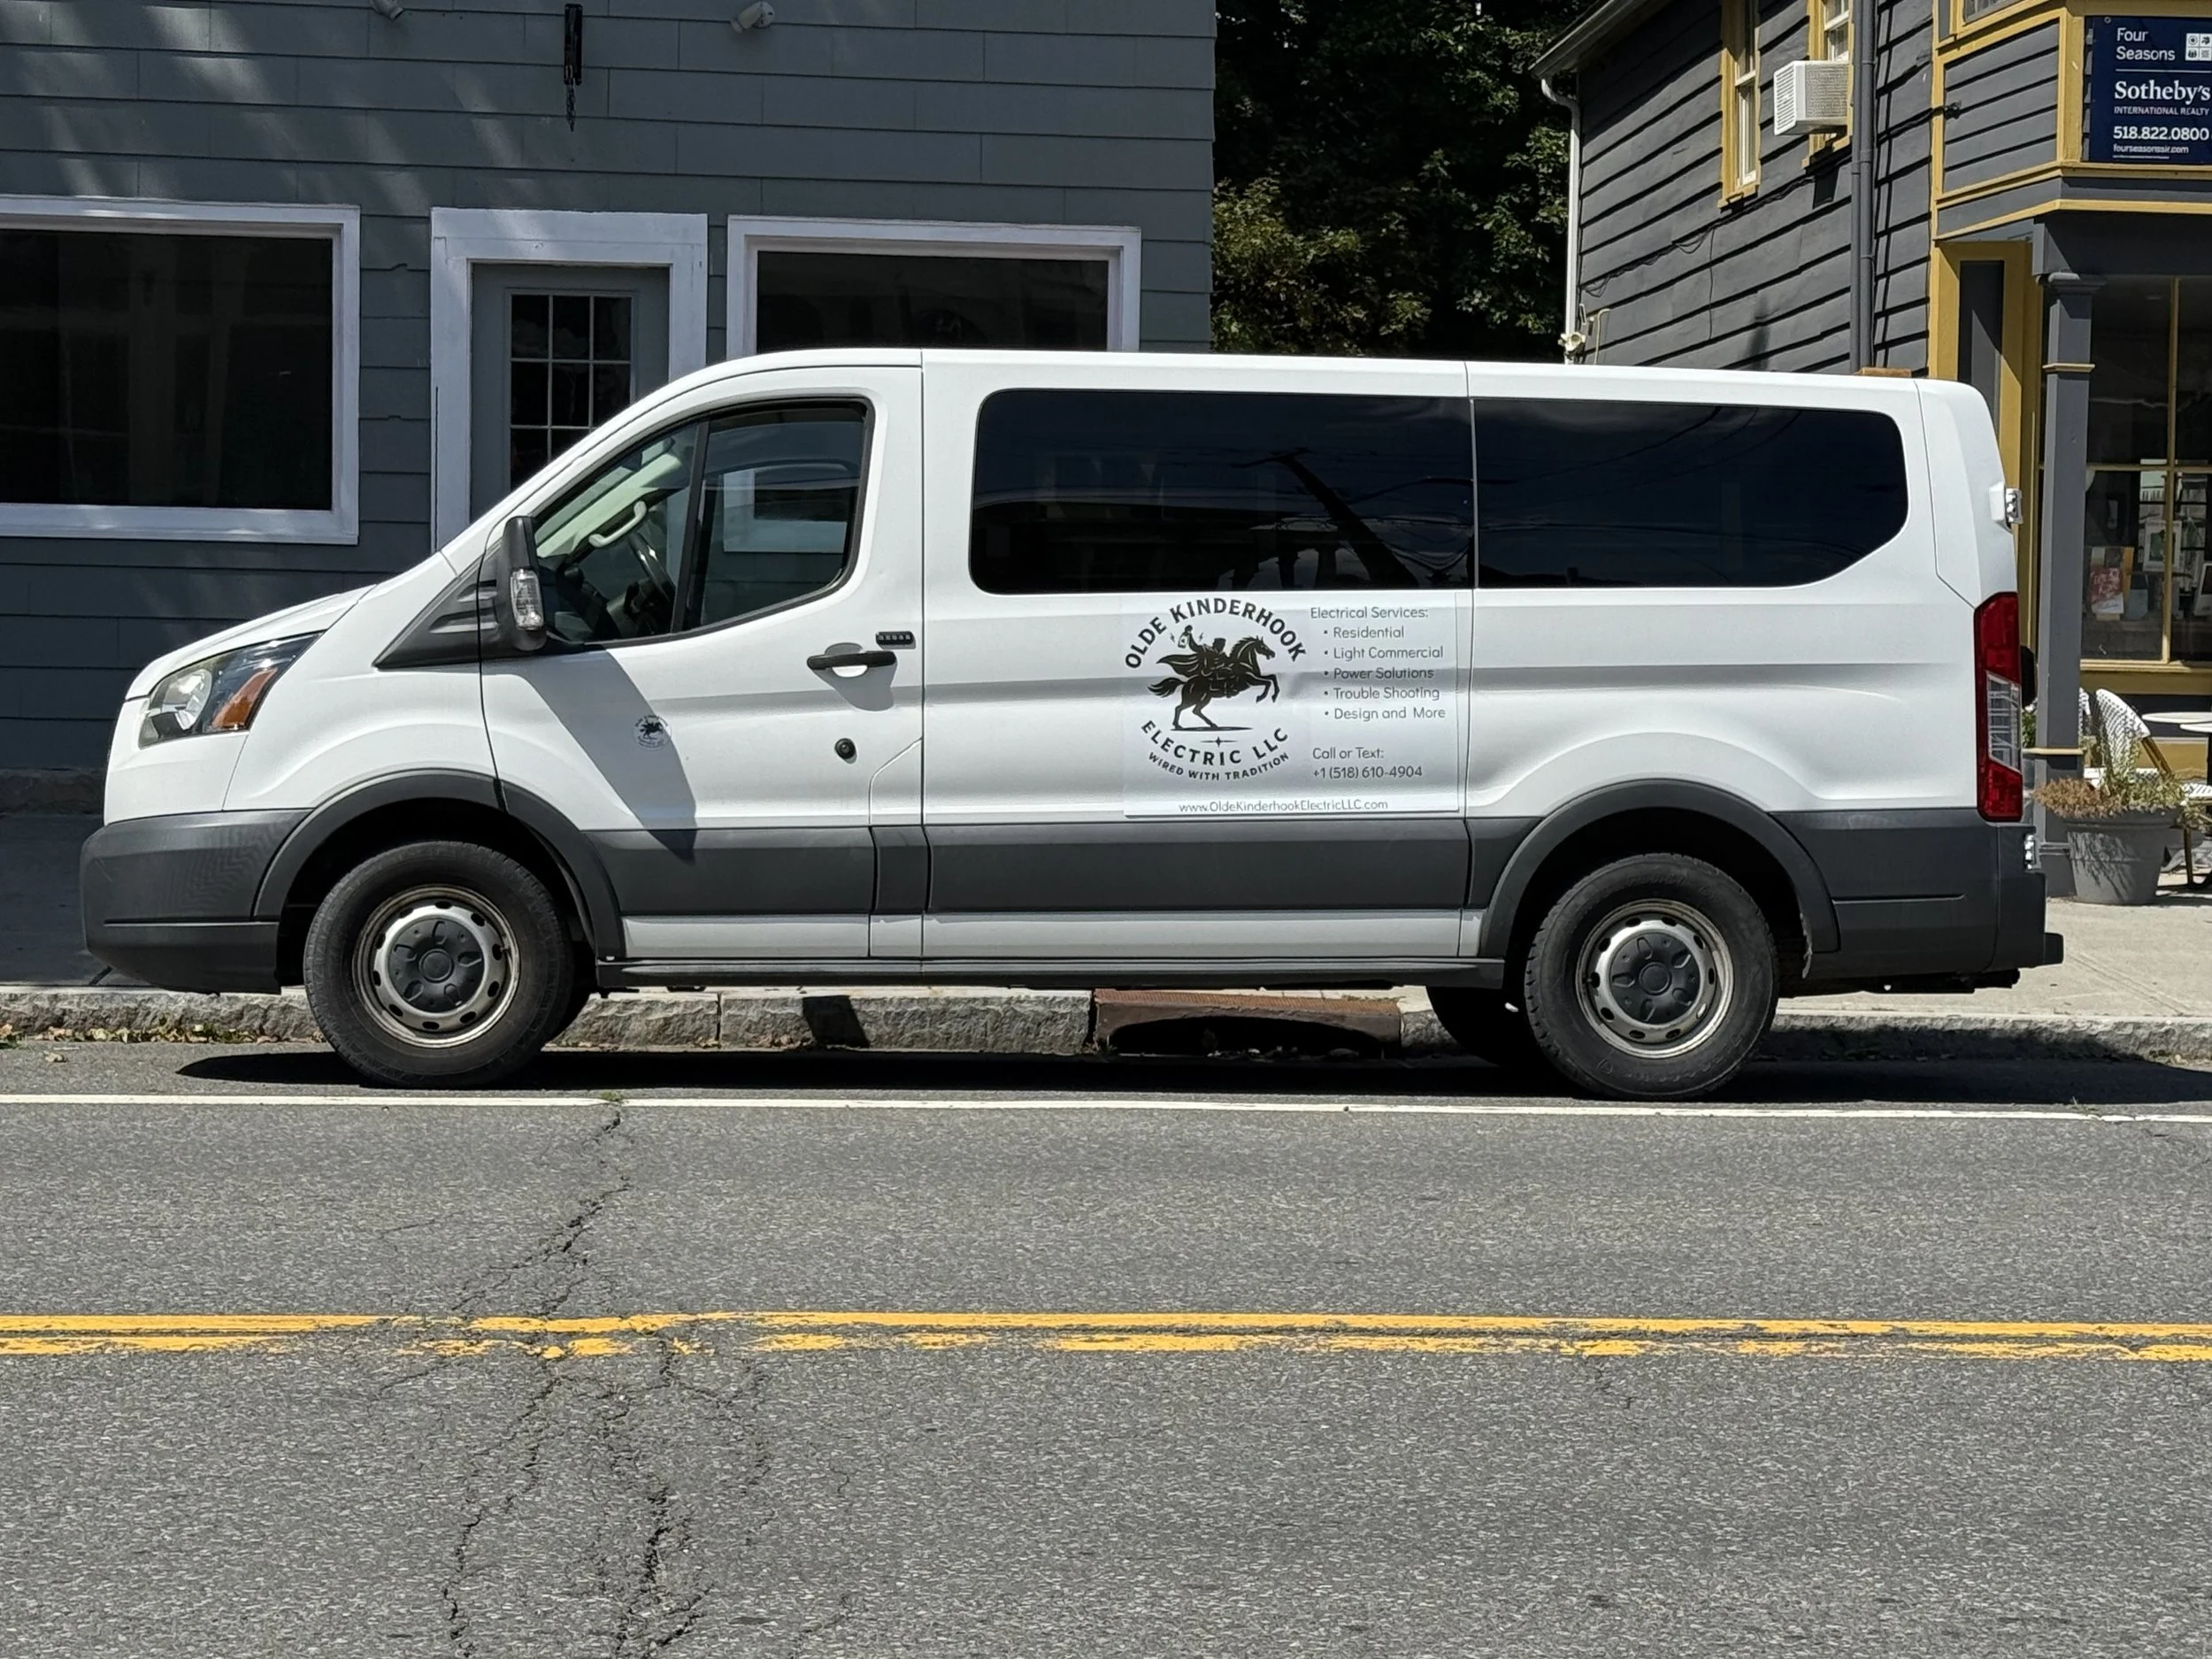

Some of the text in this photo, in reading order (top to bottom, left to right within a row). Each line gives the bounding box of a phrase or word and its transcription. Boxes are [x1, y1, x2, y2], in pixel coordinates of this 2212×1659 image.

[2116, 27, 2148, 42] Four
[2116, 46, 2176, 61] Seasons
[2115, 79, 2211, 105] Sotheby's
[2114, 105, 2210, 116] INTERNATIONAL REALTY
[2113, 126, 2209, 141] 518.822.0800
[2113, 142, 2189, 154] fourseasonssir.com
[1310, 606, 1429, 619] Electrical Services:
[1125, 597, 1307, 669] OLDE KINDERHOOK
[1333, 625, 1405, 639] Residential
[1333, 645, 1444, 662] Light Commercial
[1333, 667, 1435, 680] Power Solutions
[1333, 687, 1440, 702] Trouble Shooting
[1334, 707, 1447, 722] Design and More
[1141, 720, 1288, 766] ELECTRIC LLC
[1312, 747, 1385, 760] Call or Text:
[1148, 751, 1289, 781] WIRED WITH TRADITION
[1313, 765, 1423, 780] +1 (518) 610-4904
[1179, 799, 1388, 813] www.OldeKinderhookElectricLLC.com
